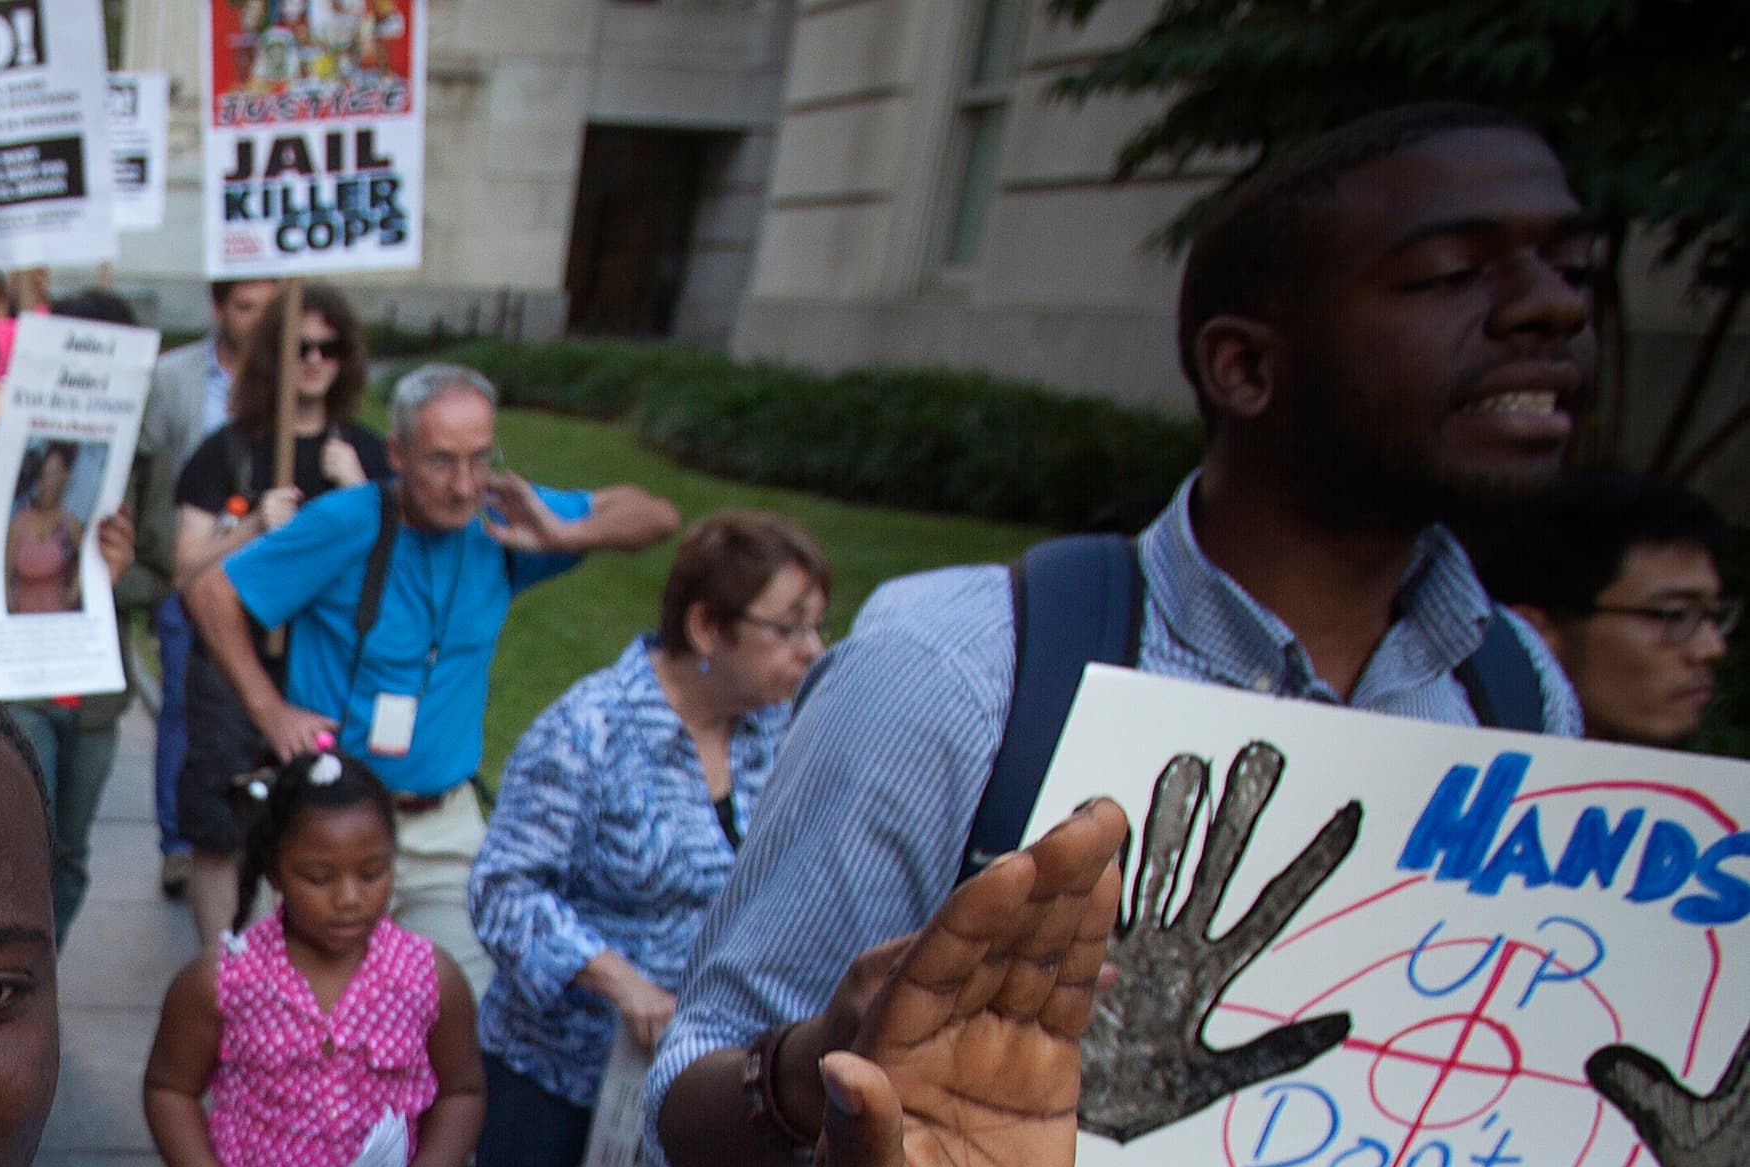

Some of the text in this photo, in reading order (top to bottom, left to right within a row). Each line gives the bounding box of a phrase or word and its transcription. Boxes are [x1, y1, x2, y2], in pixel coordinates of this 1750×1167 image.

[223, 127, 392, 182] JAIL
[223, 178, 405, 222] KILLER
[275, 213, 408, 254] COPS
[1396, 751, 1750, 926] HANDS
[1407, 916, 1605, 1010] UP
